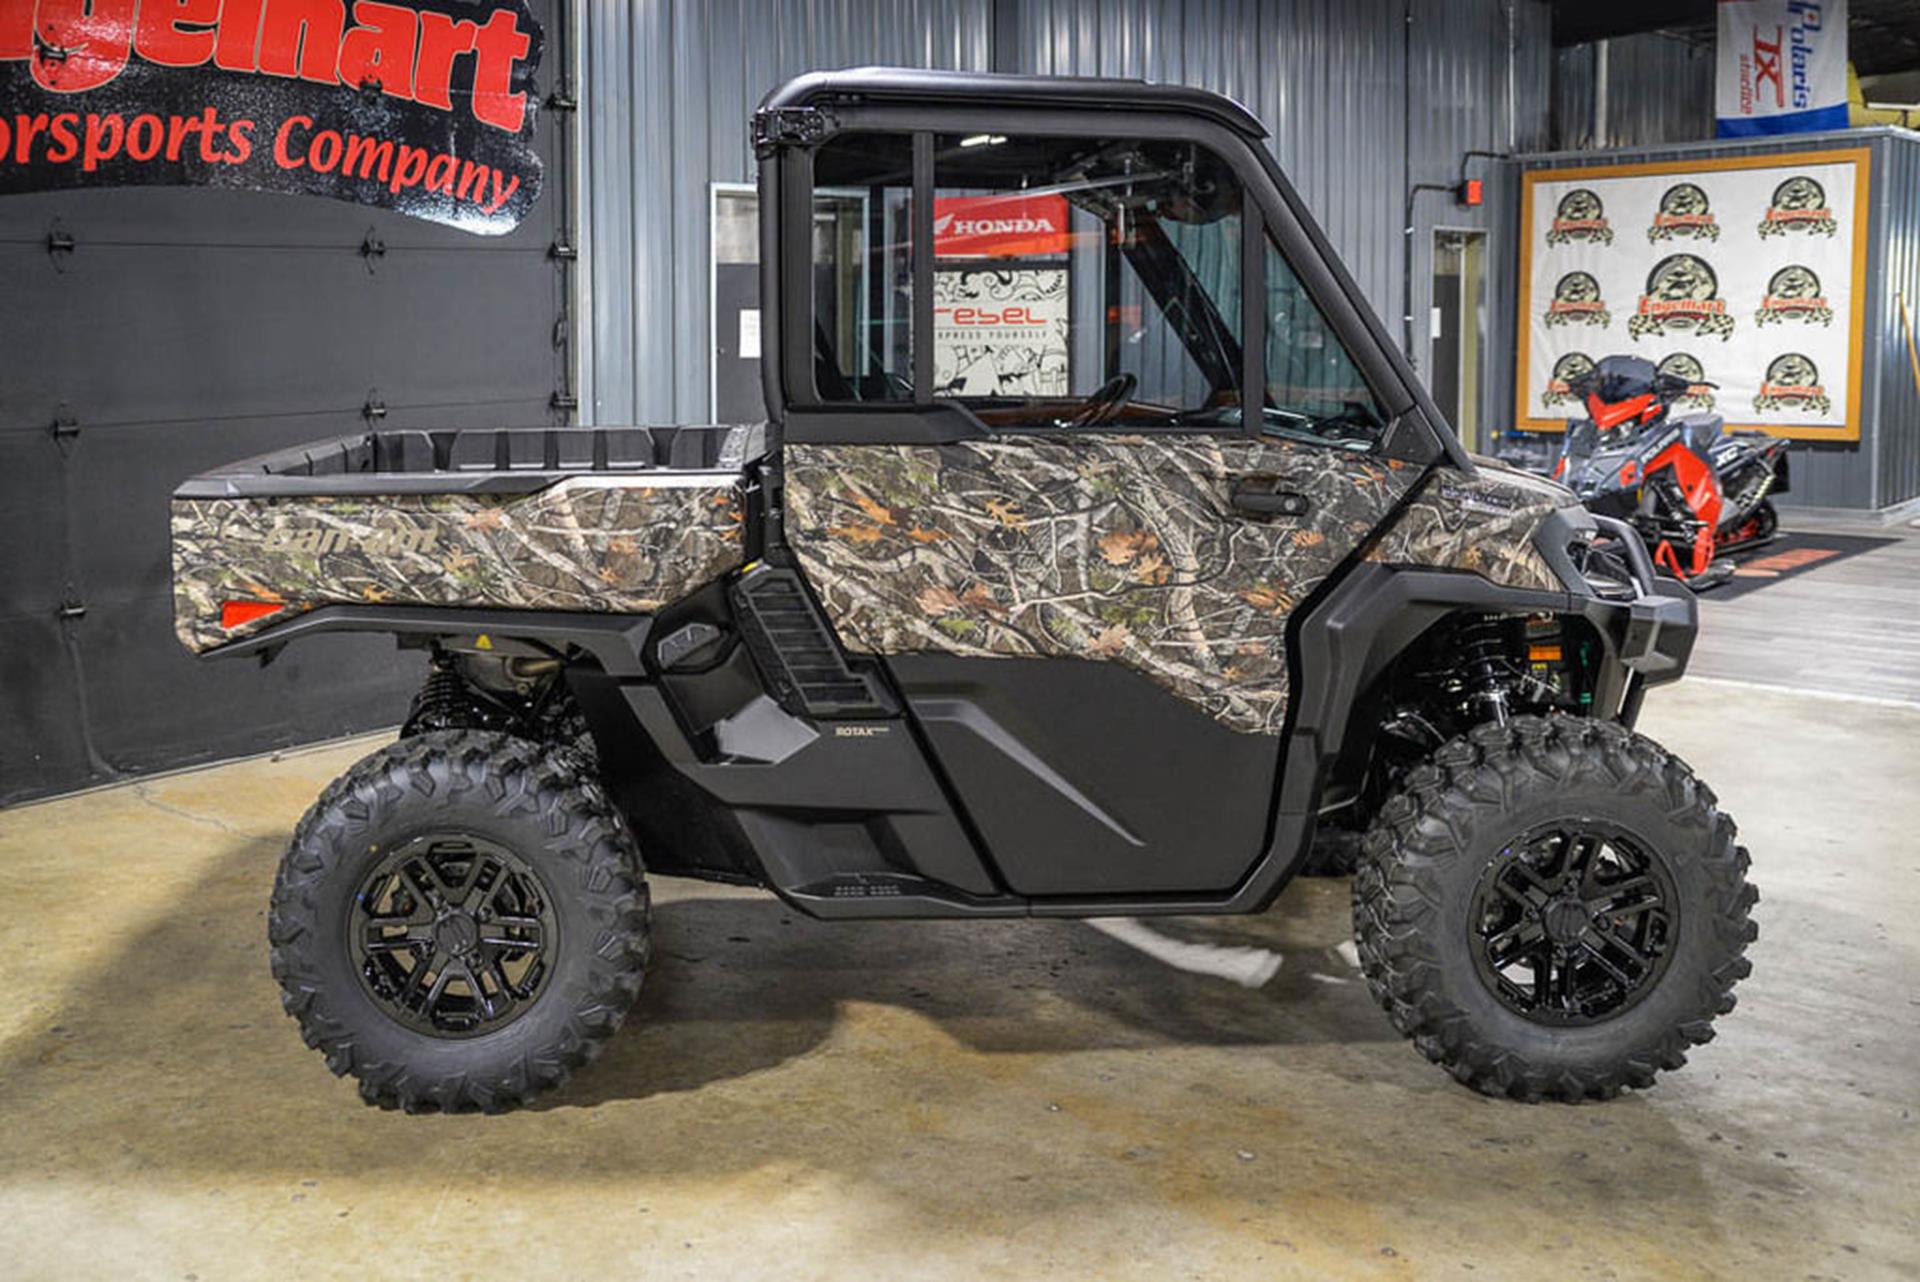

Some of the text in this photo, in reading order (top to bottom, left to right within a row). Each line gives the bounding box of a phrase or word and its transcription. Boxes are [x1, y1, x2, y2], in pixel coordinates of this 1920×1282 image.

[1787, 0, 1822, 109] Polaris
[273, 116, 520, 215] Company
[954, 218, 1055, 235] HONDA
[835, 726, 873, 736] ROTAX
